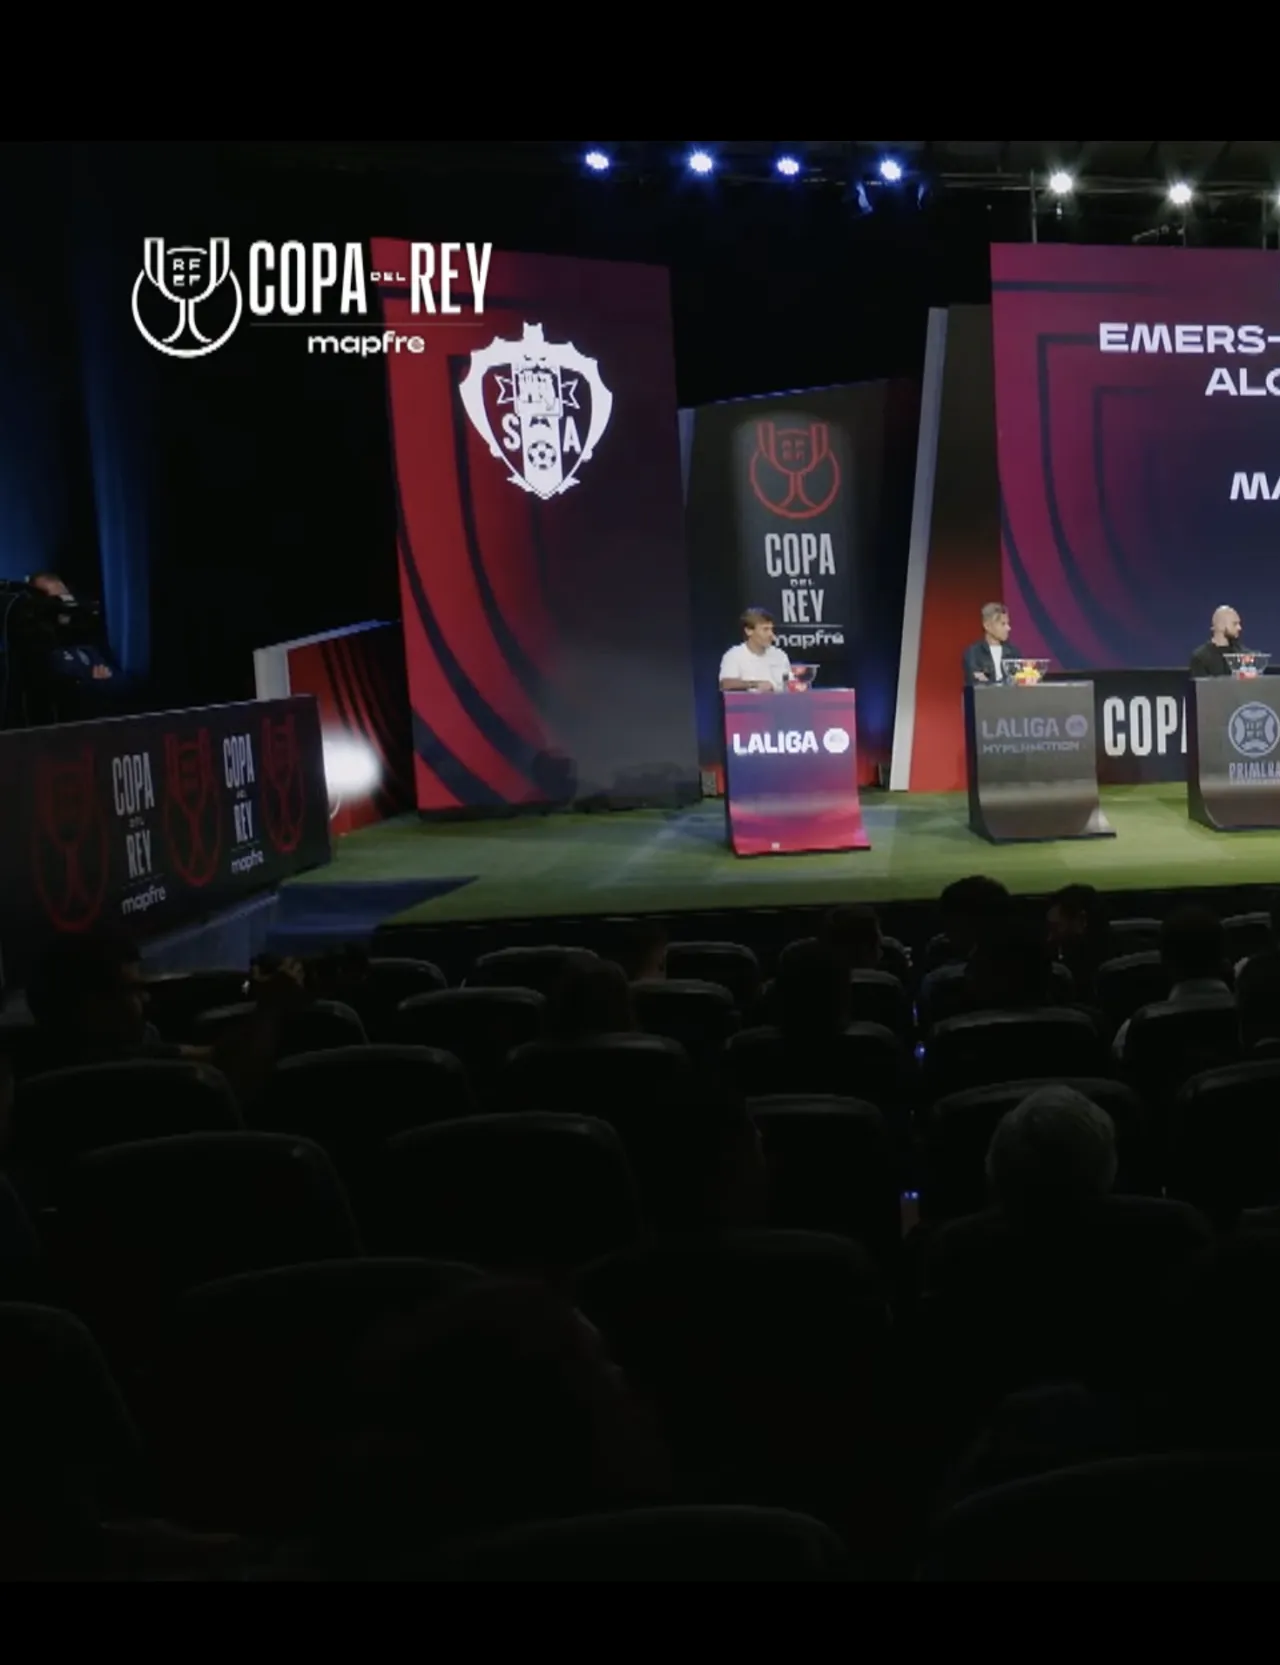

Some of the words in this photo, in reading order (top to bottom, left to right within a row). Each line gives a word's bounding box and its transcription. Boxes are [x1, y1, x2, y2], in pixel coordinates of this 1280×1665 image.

[501, 412, 521, 452] S
[562, 415, 583, 455] A
[764, 533, 836, 577] COPA
[781, 588, 825, 623] REY
[732, 730, 819, 756] LALIGA
[982, 717, 1059, 738] LALIGA
[223, 733, 255, 788] COPA
[112, 752, 155, 816] COPA
[234, 800, 253, 843] REY
[126, 829, 152, 878] REY
